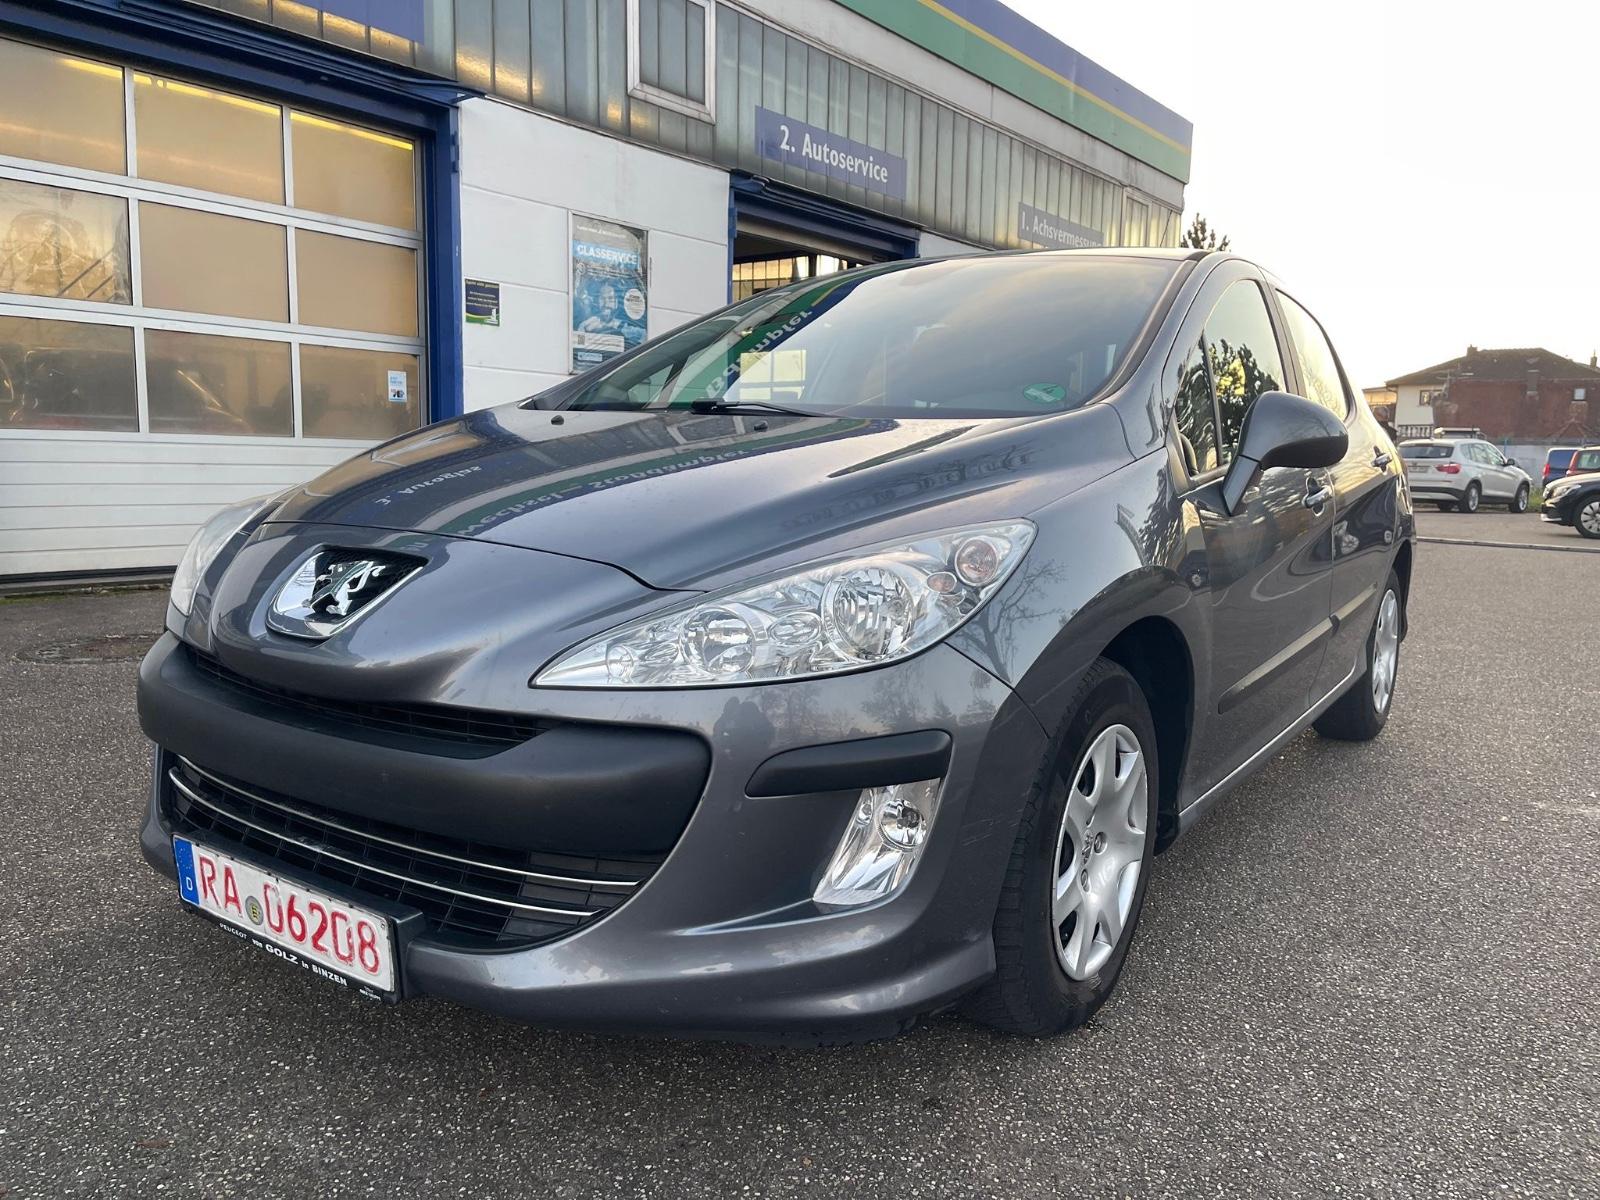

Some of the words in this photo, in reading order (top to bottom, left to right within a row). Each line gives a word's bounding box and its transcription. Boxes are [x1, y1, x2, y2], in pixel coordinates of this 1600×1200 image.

[780, 125, 795, 152] 2.
[802, 133, 888, 183] Autoservice
[186, 876, 193, 891] D
[199, 856, 243, 917] RA
[263, 883, 380, 974] 06208
[219, 922, 248, 940] PEUGEOT
[265, 943, 299, 965] GOLZ
[312, 964, 348, 987] BINZEN
